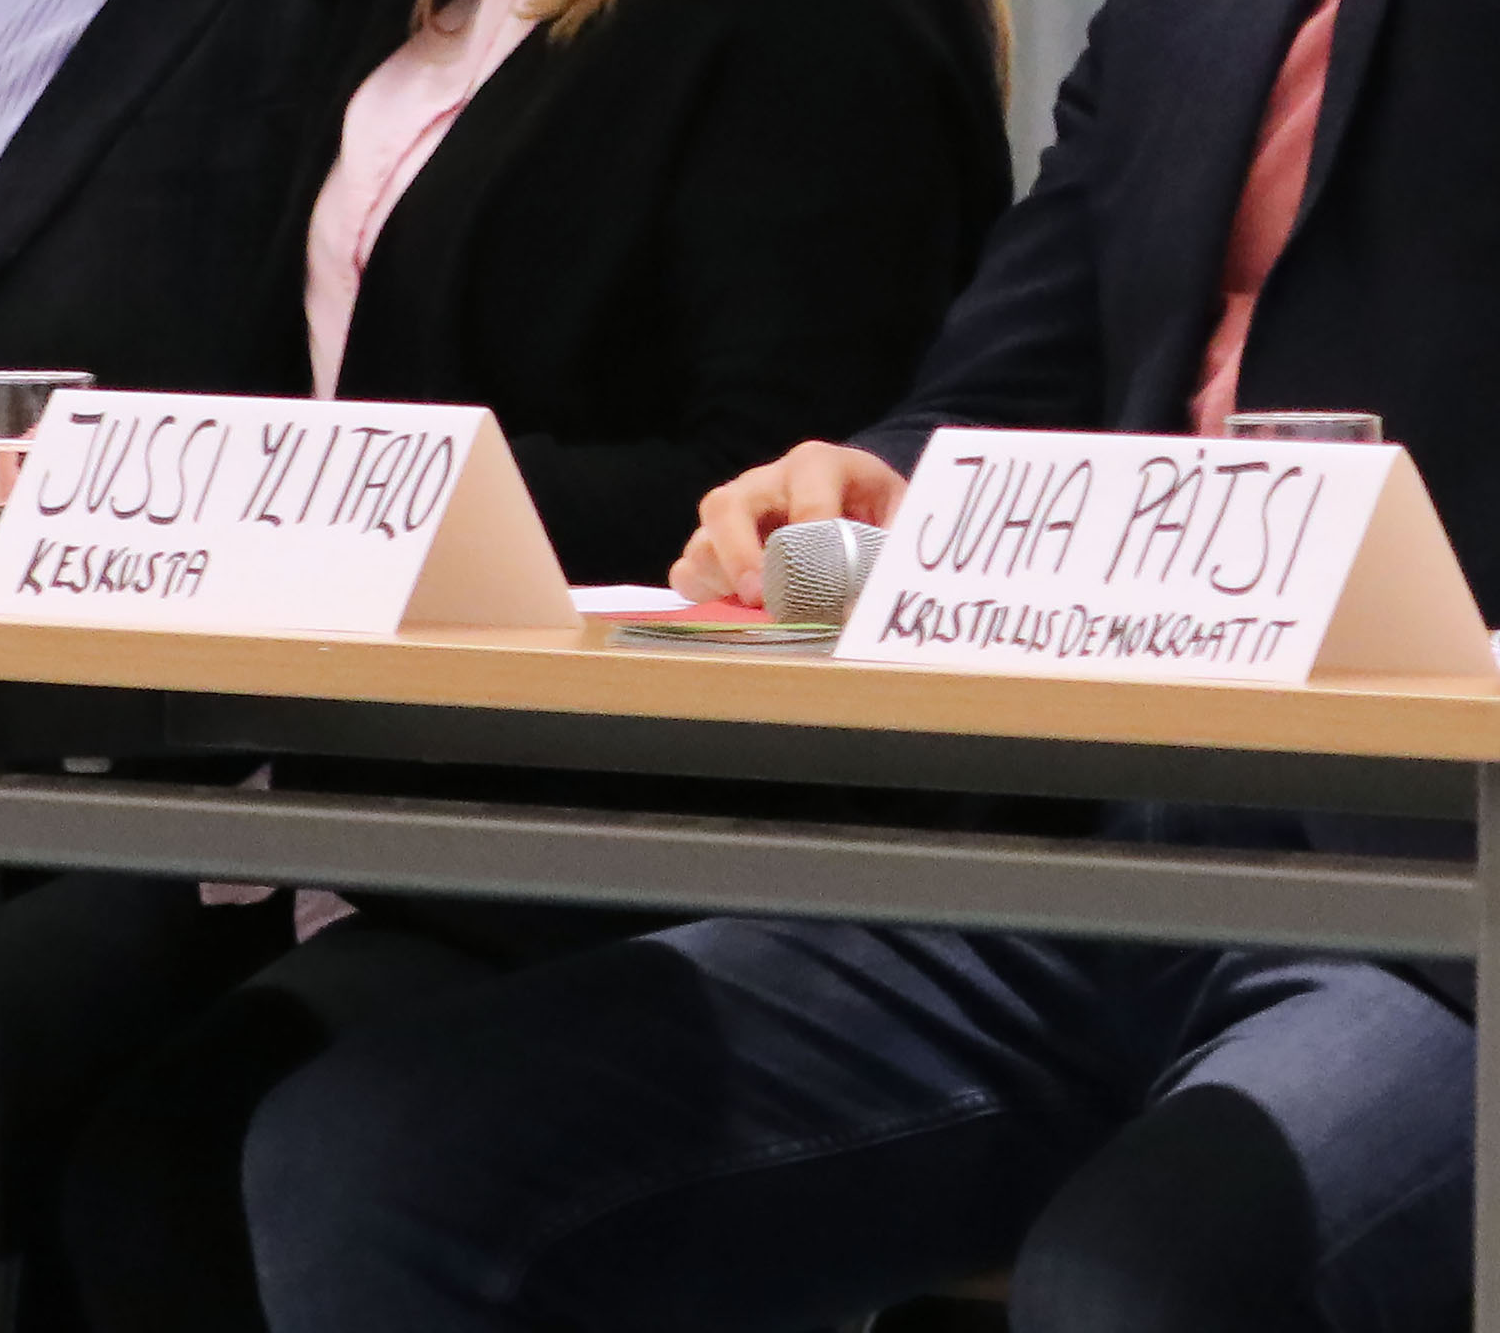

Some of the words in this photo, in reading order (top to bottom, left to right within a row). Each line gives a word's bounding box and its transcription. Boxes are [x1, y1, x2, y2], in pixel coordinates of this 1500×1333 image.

[37, 413, 231, 525] JUSSI
[916, 456, 1093, 577] JUHA
[16, 538, 210, 598] KESKUSTA
